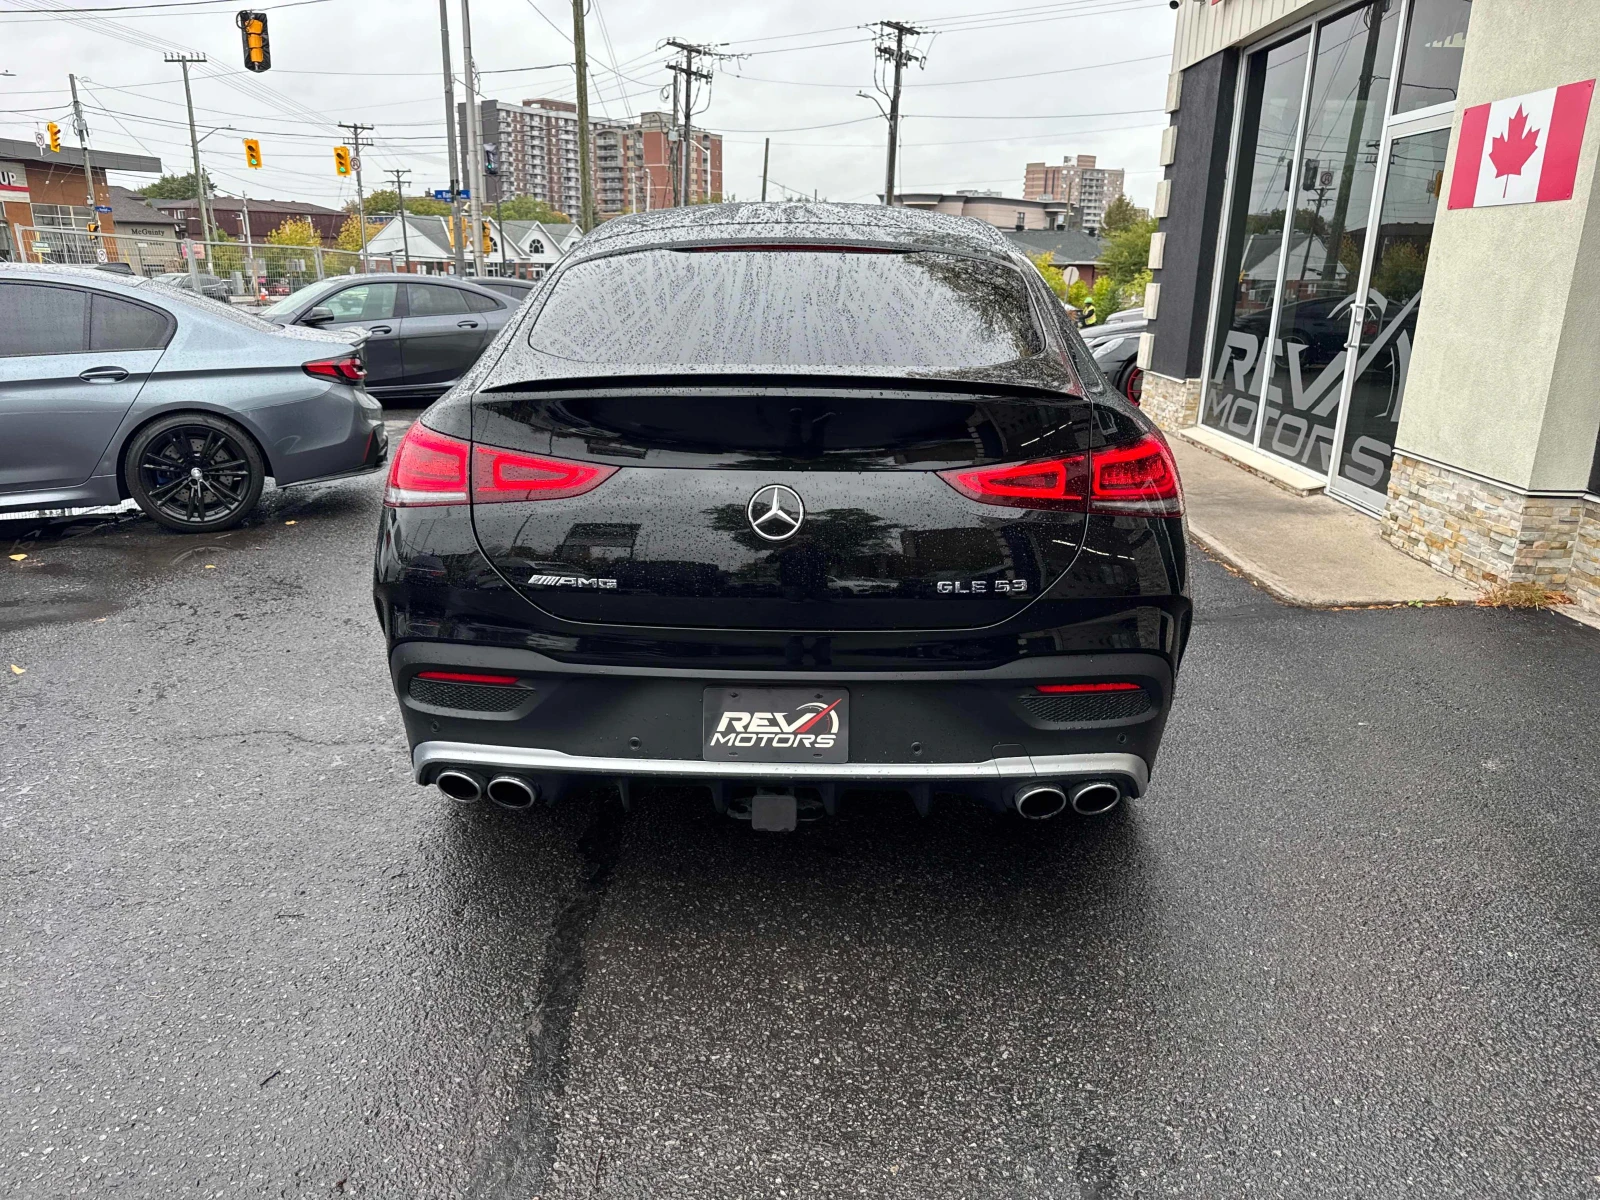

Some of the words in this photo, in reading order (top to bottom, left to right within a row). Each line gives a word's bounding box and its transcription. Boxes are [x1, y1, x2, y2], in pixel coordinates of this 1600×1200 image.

[131, 228, 165, 236] McGuinty
[1205, 388, 1391, 487] MOTORS
[937, 581, 987, 593] GLE
[994, 579, 1028, 592] 53
[716, 711, 816, 733] REV
[710, 732, 837, 748] MOTORS
